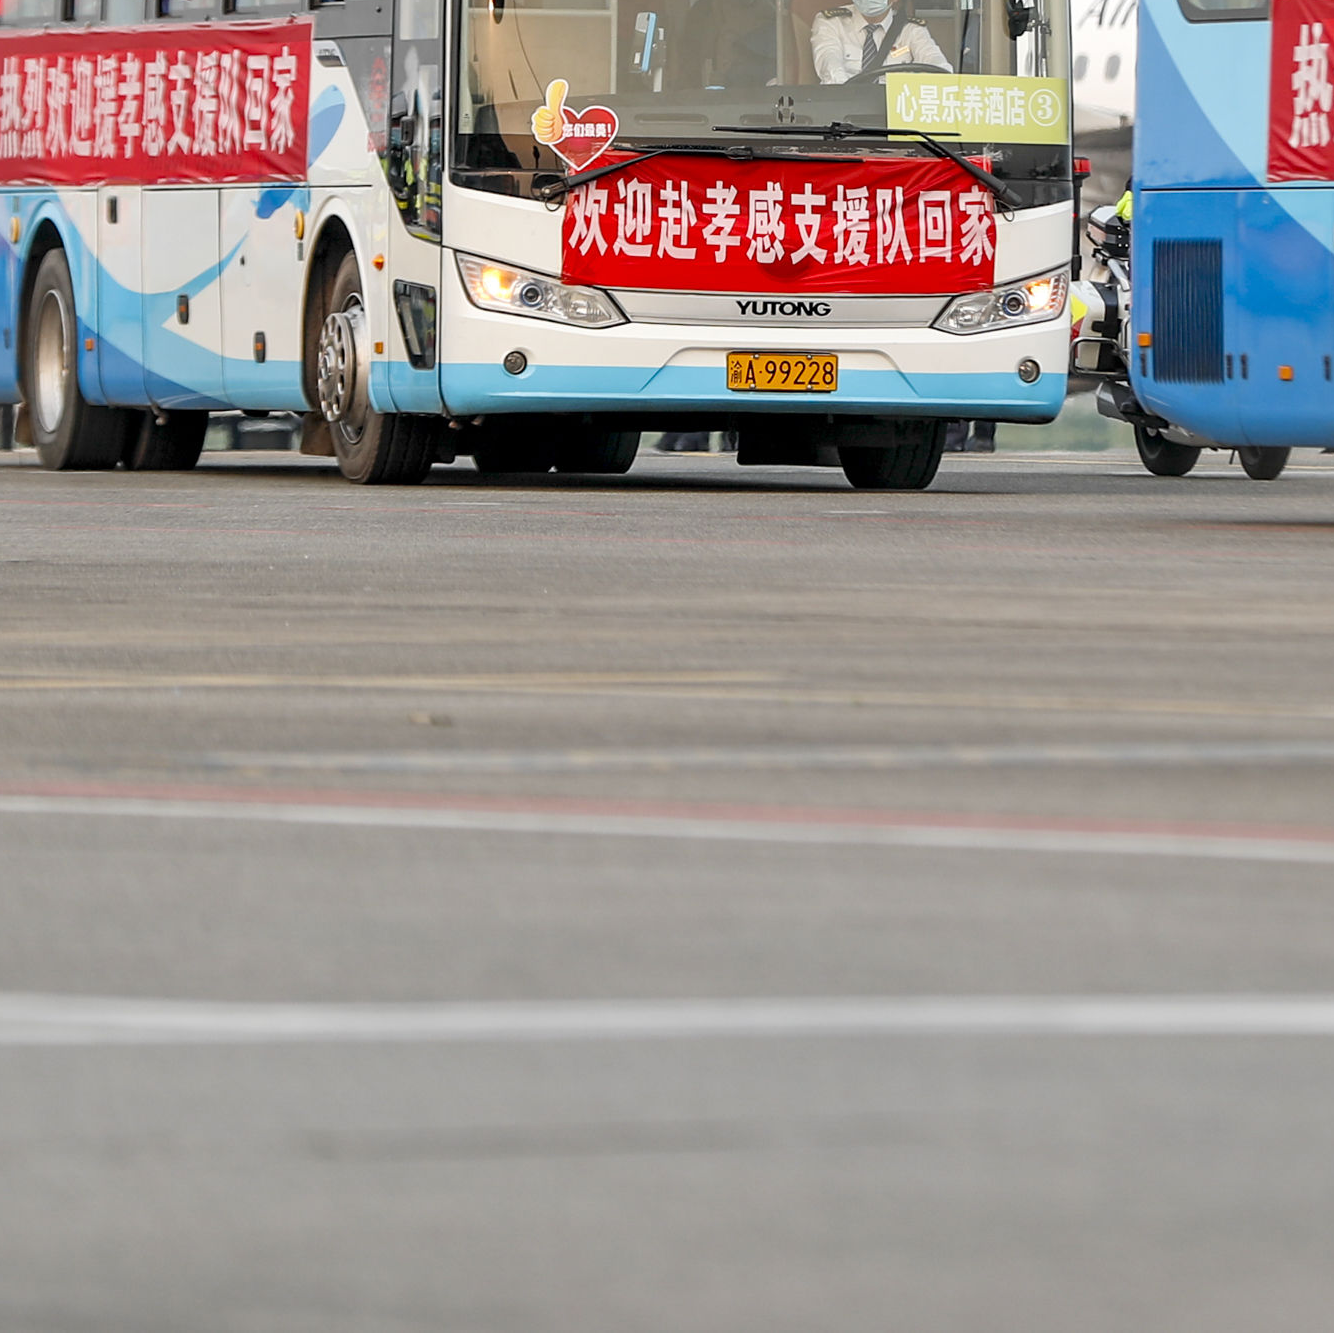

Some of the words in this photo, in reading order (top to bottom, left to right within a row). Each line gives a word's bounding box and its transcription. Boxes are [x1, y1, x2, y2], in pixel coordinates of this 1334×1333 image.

[568, 177, 995, 266] 欢迎赴孝感支援队回家
[736, 301, 832, 316] YUTONG
